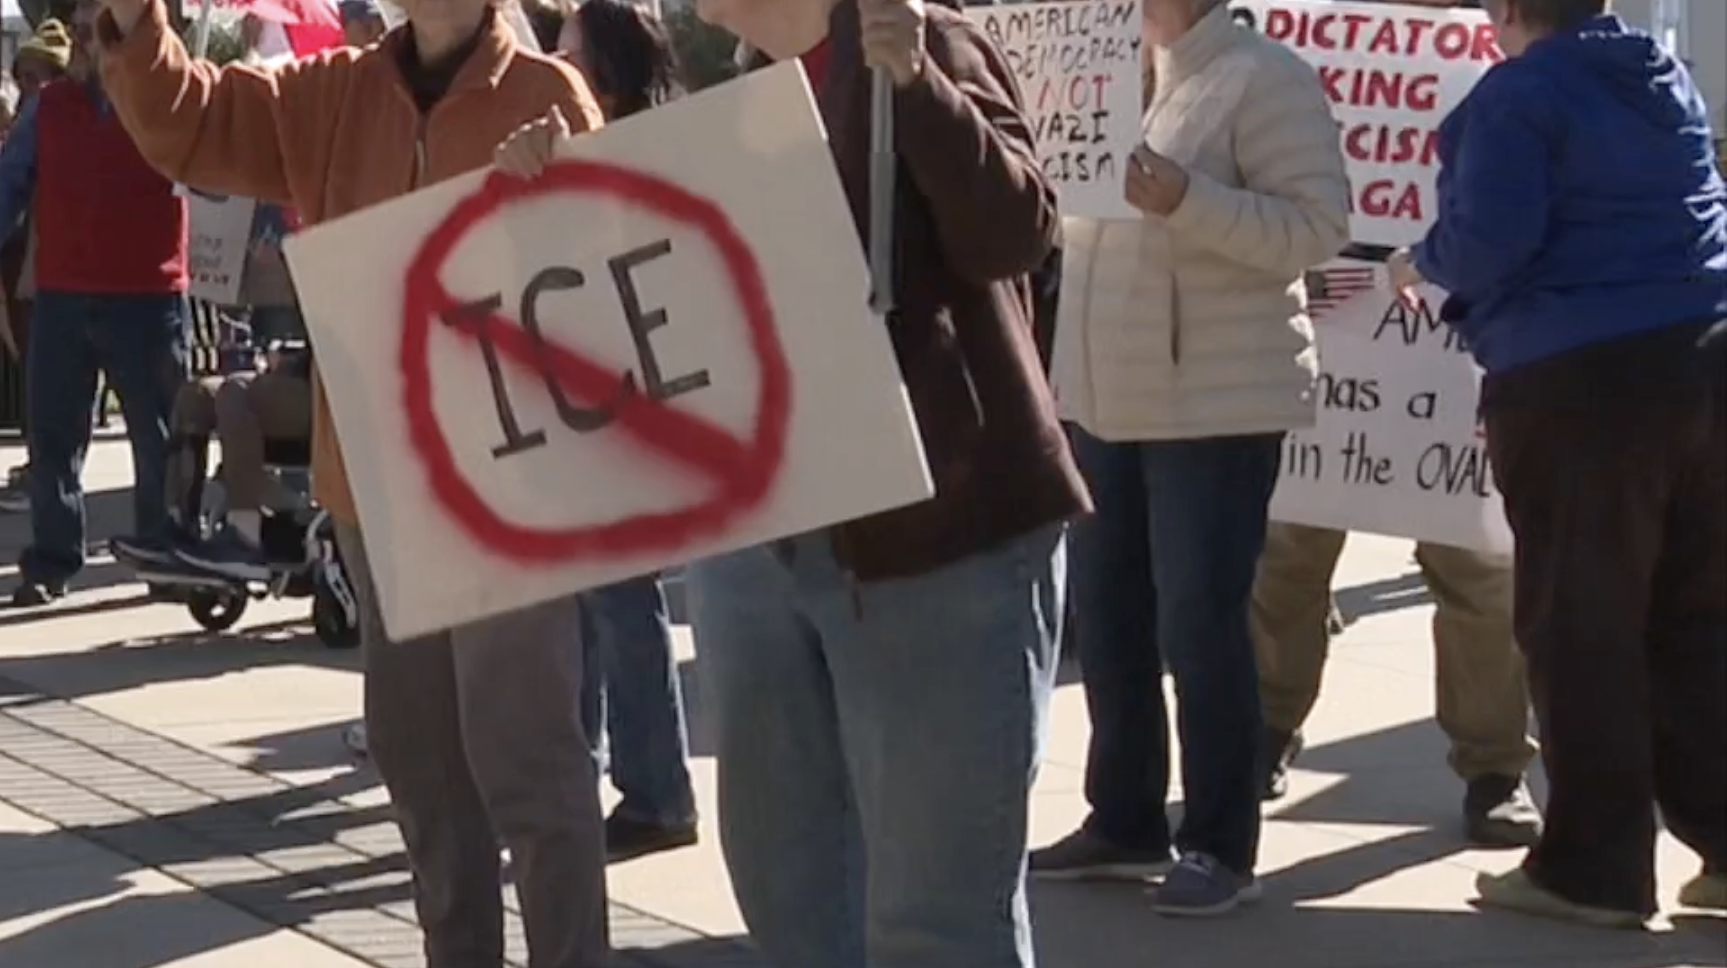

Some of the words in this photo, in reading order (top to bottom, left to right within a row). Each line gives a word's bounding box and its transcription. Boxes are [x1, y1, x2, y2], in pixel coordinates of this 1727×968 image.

[984, 0, 1137, 44] AMERICAN
[1265, 8, 1503, 64] DICTATOR
[1036, 74, 1112, 111] NOT
[1319, 65, 1440, 111] KING
[439, 237, 711, 459] ICE
[1406, 391, 1437, 419] a
[1288, 435, 1322, 480] in
[1340, 432, 1394, 485] the
[1416, 442, 1491, 498] OVAL
